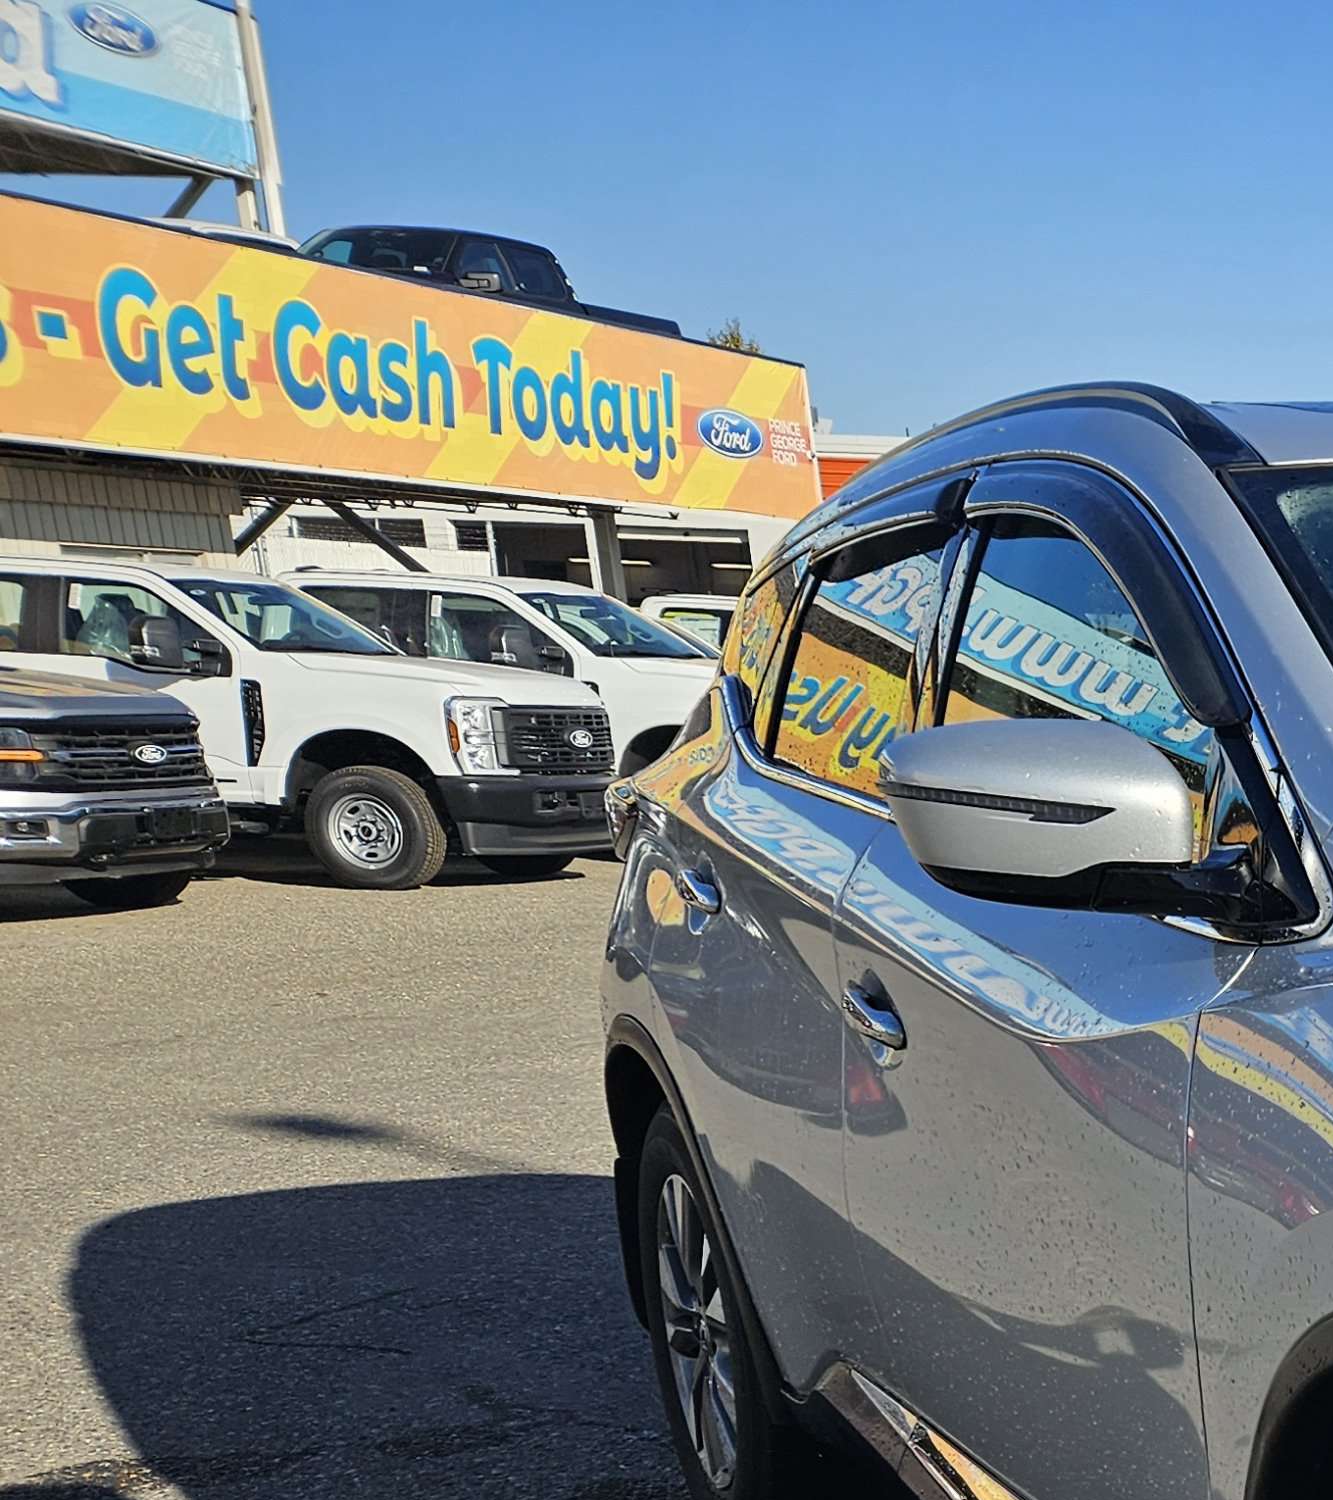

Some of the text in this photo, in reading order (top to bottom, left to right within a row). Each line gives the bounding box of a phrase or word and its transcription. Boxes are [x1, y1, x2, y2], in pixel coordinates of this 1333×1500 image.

[98, 265, 251, 401] Get
[272, 299, 456, 429] Cash
[471, 336, 677, 480] Today!
[710, 413, 752, 452] Ford
[768, 418, 801, 437] PRINCE
[769, 432, 808, 453] GEORGE
[771, 449, 798, 466] FORD
